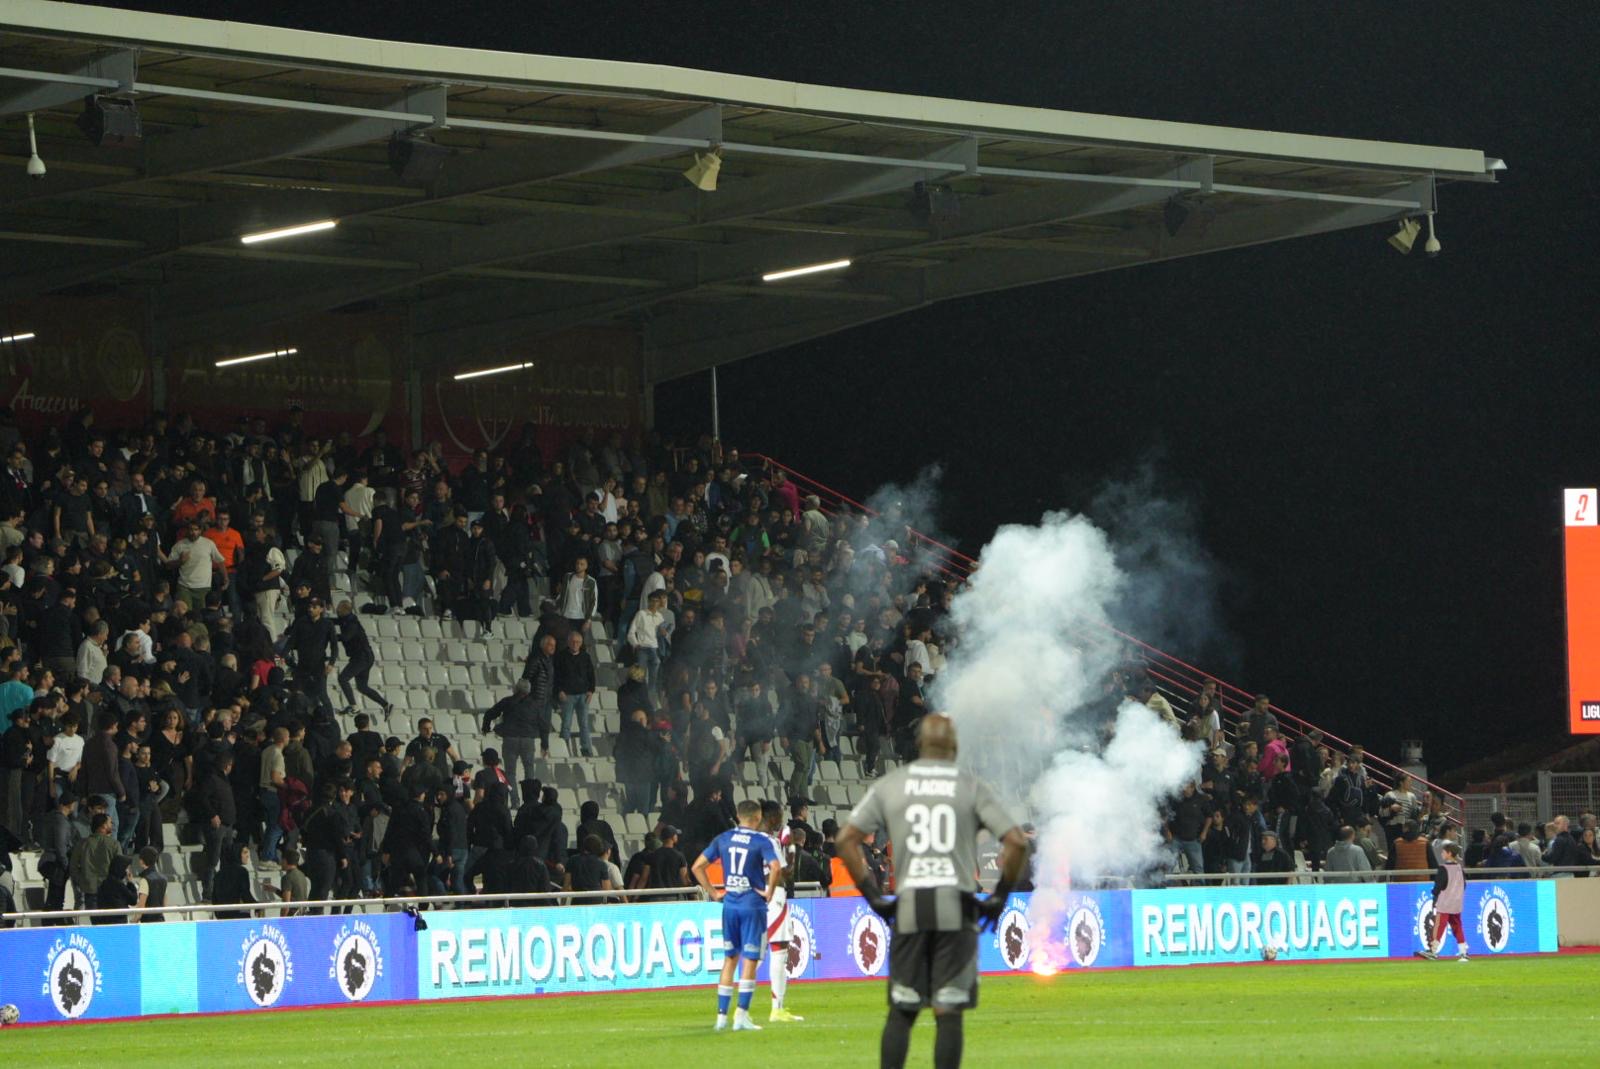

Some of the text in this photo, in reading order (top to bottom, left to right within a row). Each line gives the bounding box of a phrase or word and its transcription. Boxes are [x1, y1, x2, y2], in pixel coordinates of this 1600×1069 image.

[1574, 494, 1589, 521] 2
[905, 803, 957, 854] 30
[728, 846, 749, 876] 17
[1142, 897, 1380, 957] REMORQUAGE
[431, 919, 723, 988] REMORQUAGE
